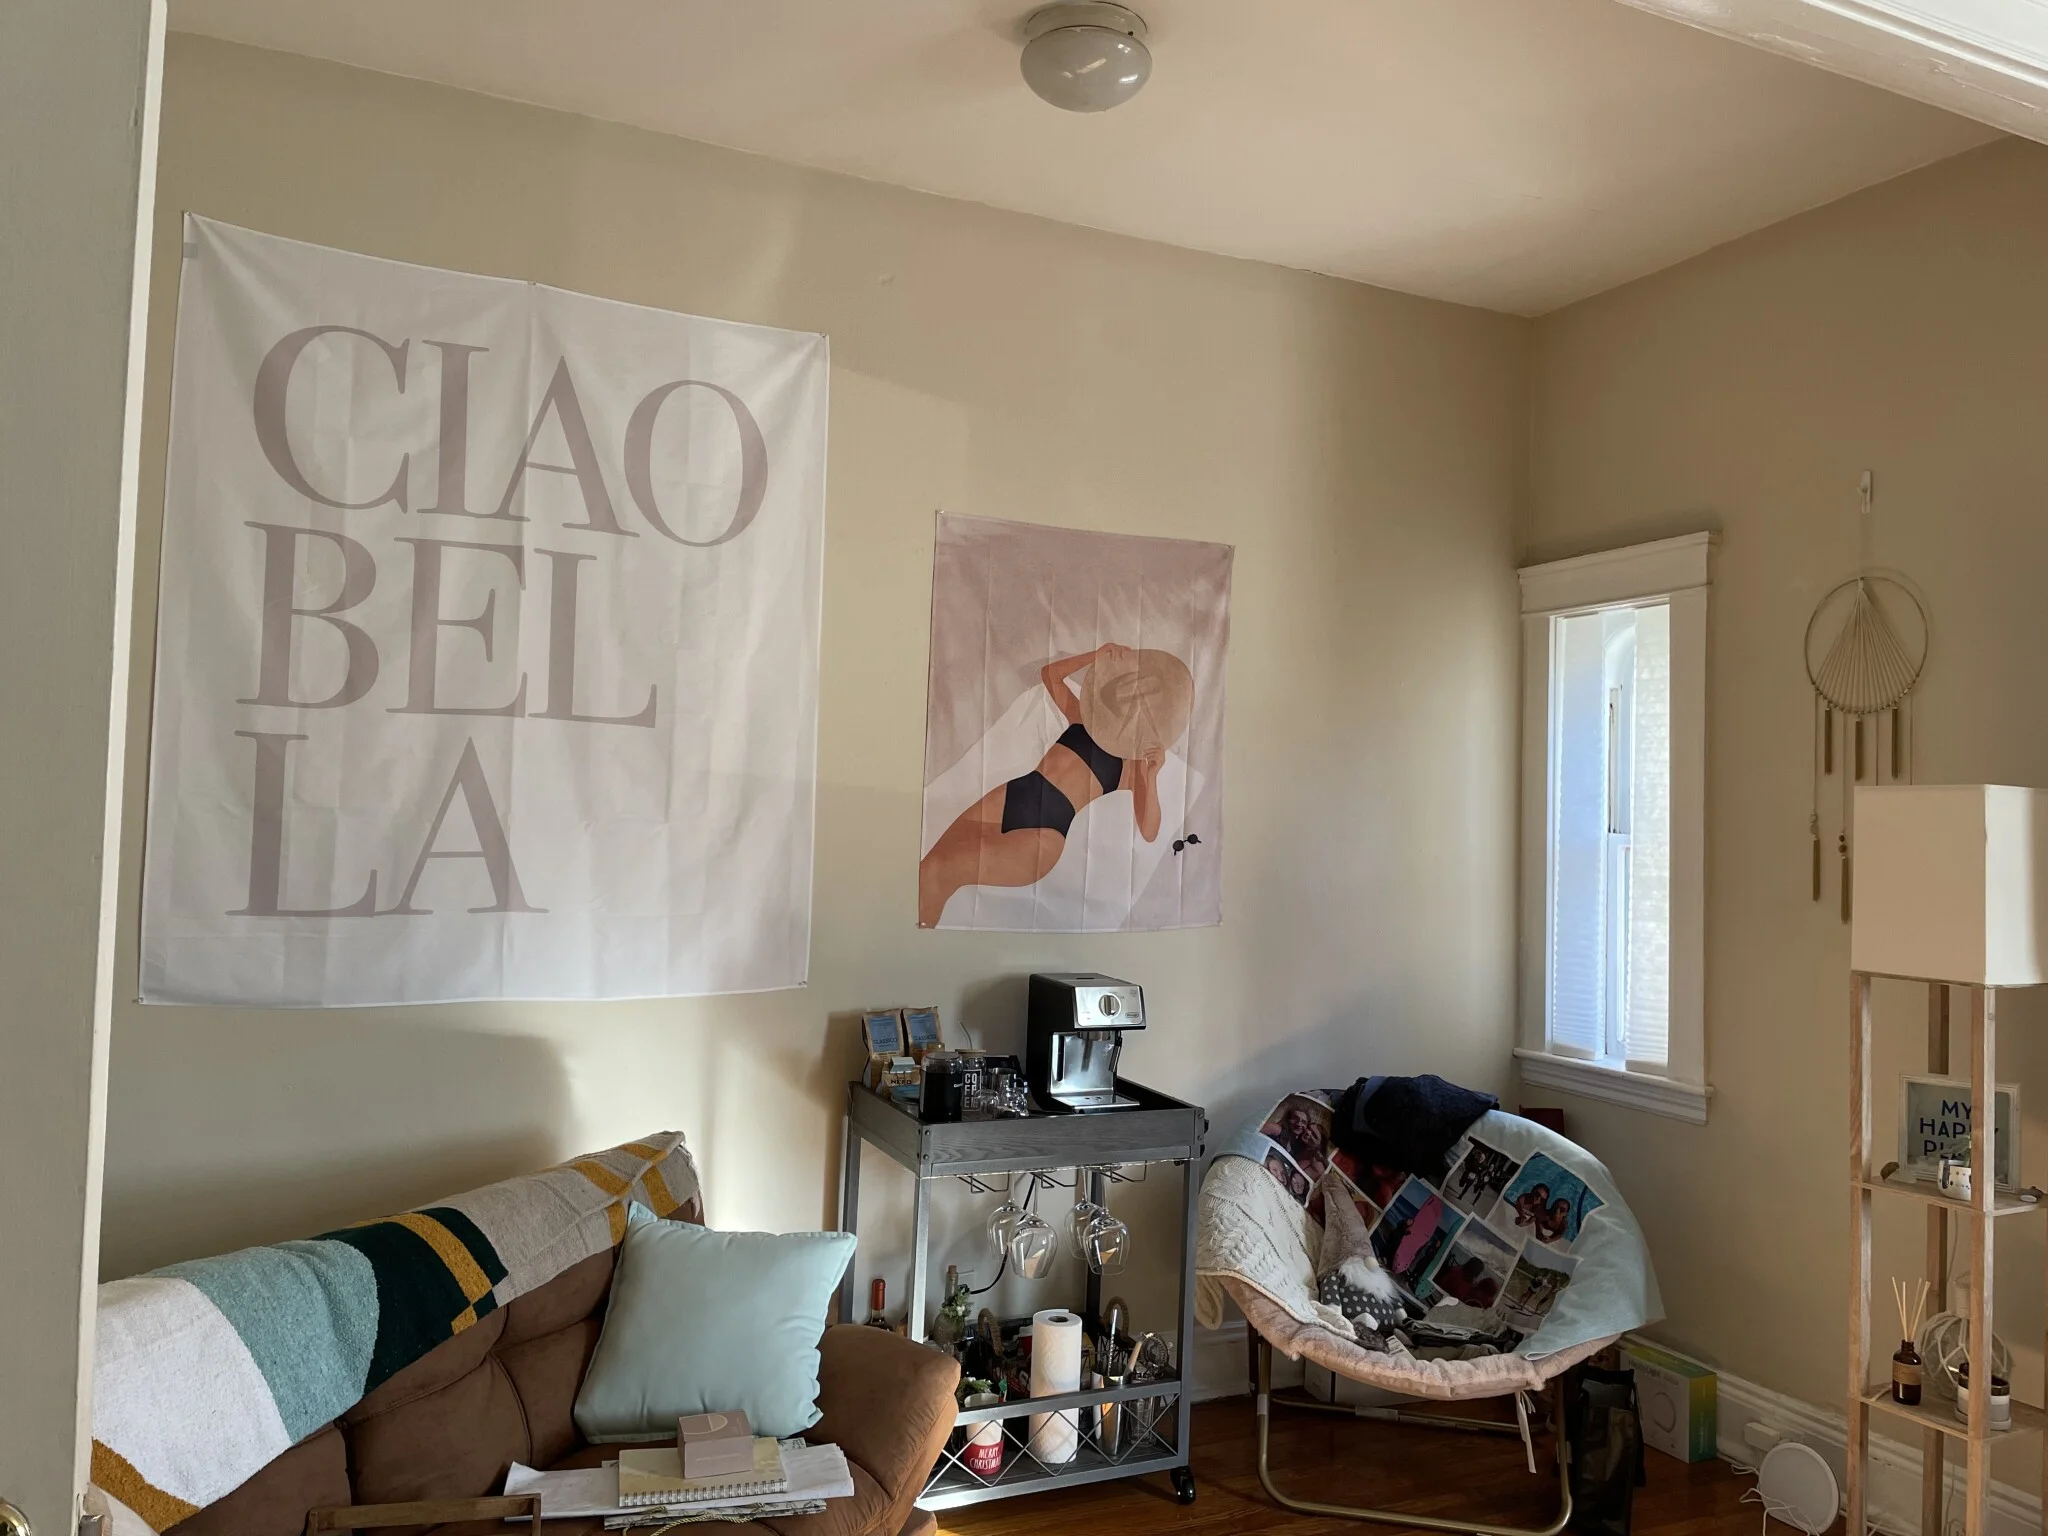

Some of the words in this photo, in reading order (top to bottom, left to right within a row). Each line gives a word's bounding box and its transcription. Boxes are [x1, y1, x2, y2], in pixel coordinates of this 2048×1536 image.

[253, 324, 768, 547] CIAO
[236, 520, 657, 729] BEL
[225, 730, 549, 917] LA
[1941, 1100, 1972, 1120] MY
[970, 1455, 1002, 1470] CHRISTMA
[978, 1447, 999, 1459] MERRY
